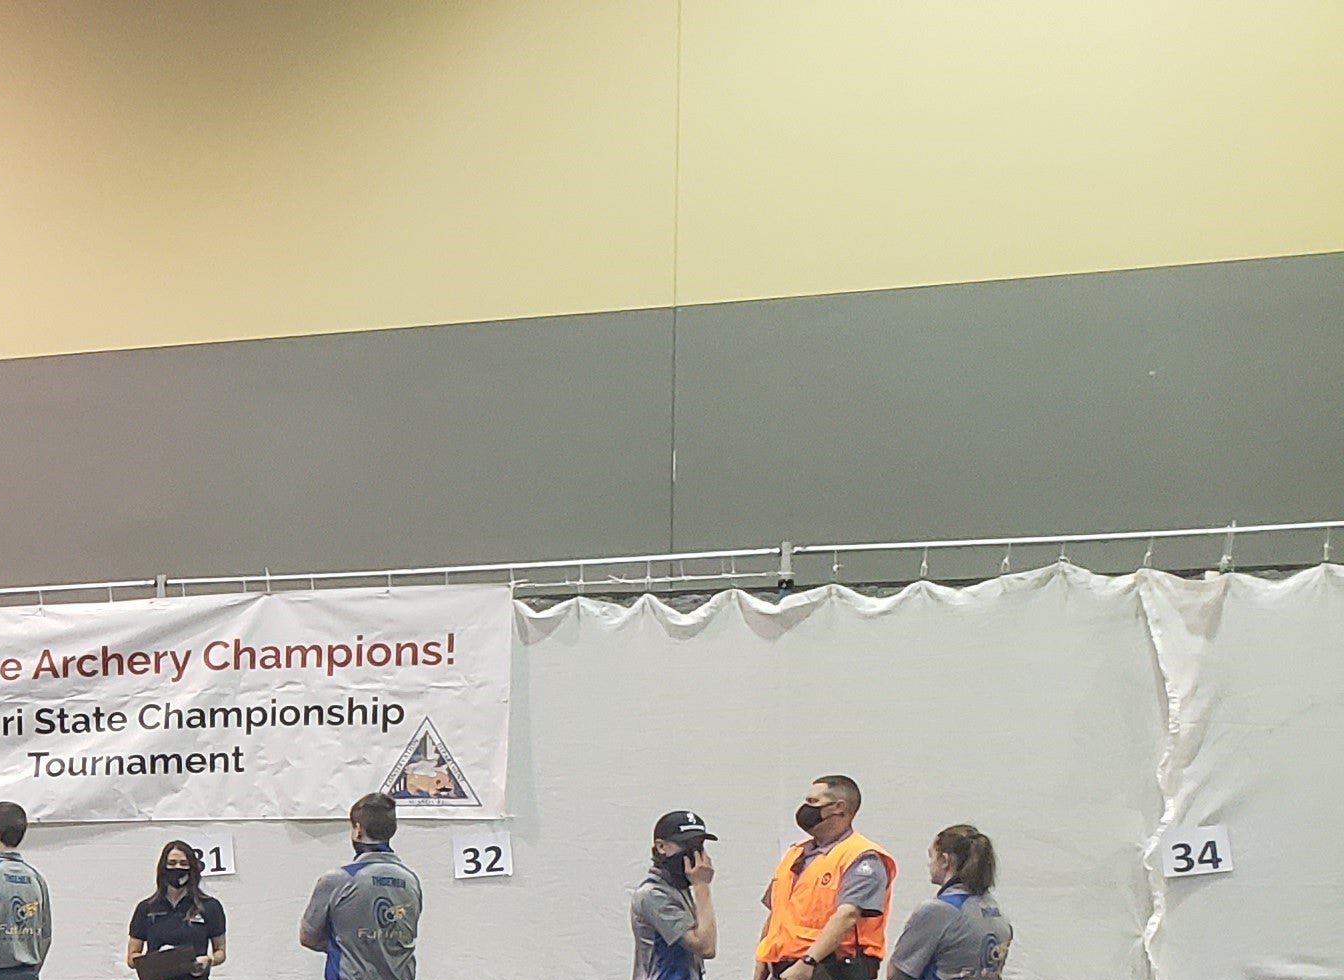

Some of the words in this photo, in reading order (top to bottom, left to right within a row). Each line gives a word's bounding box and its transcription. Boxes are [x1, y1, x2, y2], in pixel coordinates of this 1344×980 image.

[31, 645, 192, 683] Archery
[203, 633, 455, 677] Champions!
[34, 706, 127, 735] State
[137, 697, 405, 735] Championship
[27, 746, 245, 778] Tournament
[462, 845, 505, 874] 32
[1171, 840, 1223, 873] 34
